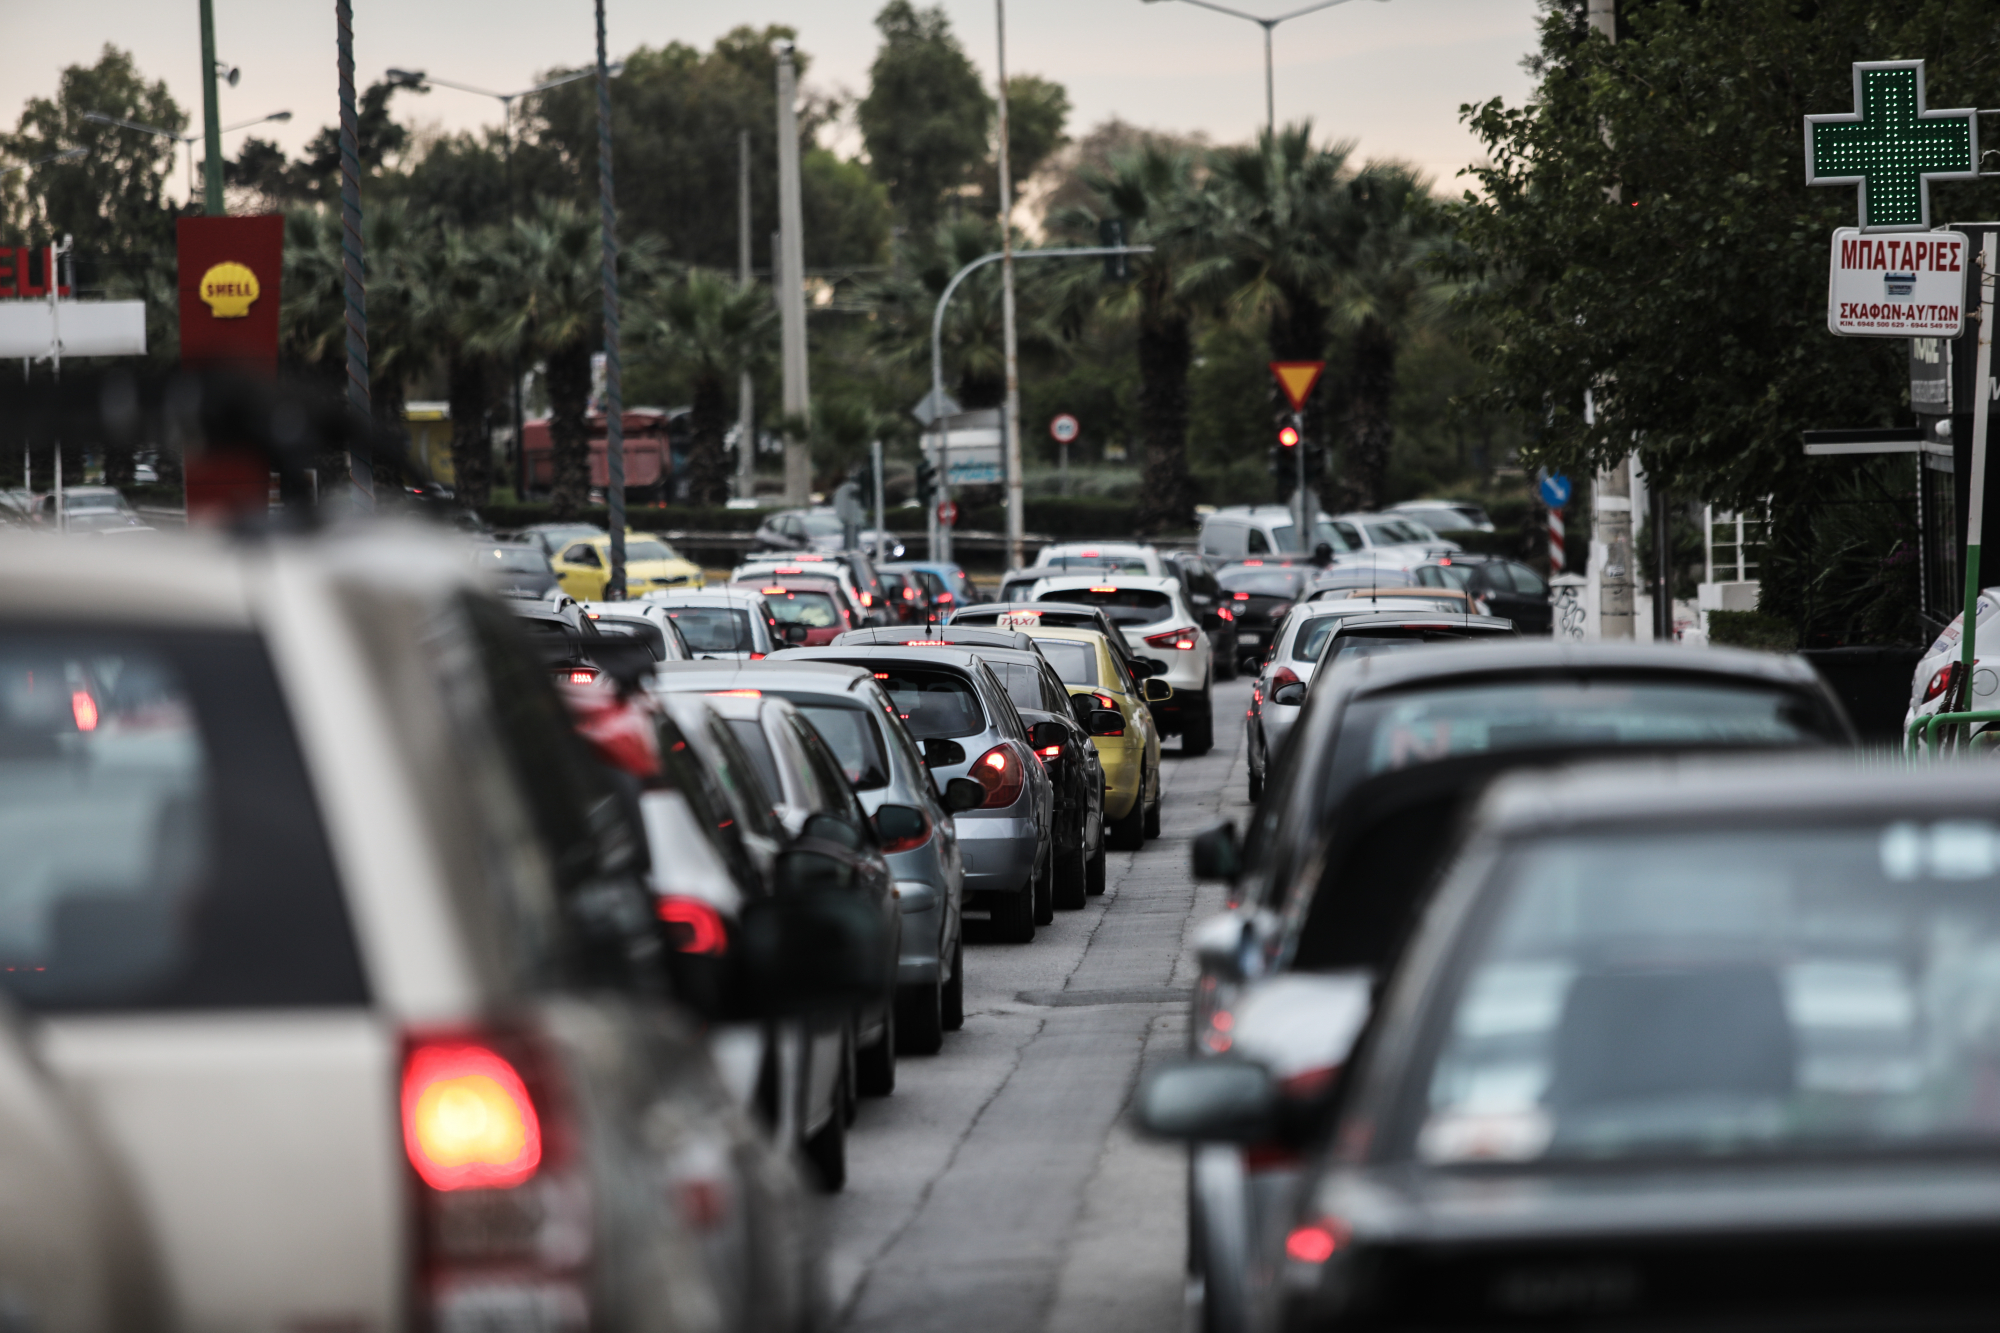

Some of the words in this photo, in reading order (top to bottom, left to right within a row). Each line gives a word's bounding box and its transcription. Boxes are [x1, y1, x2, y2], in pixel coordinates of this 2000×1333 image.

[1841, 240, 1961, 271] ΜΠΑΤΑΡΙΕΣ
[207, 283, 252, 297] SHELL
[1001, 618, 1036, 626] TAXI
